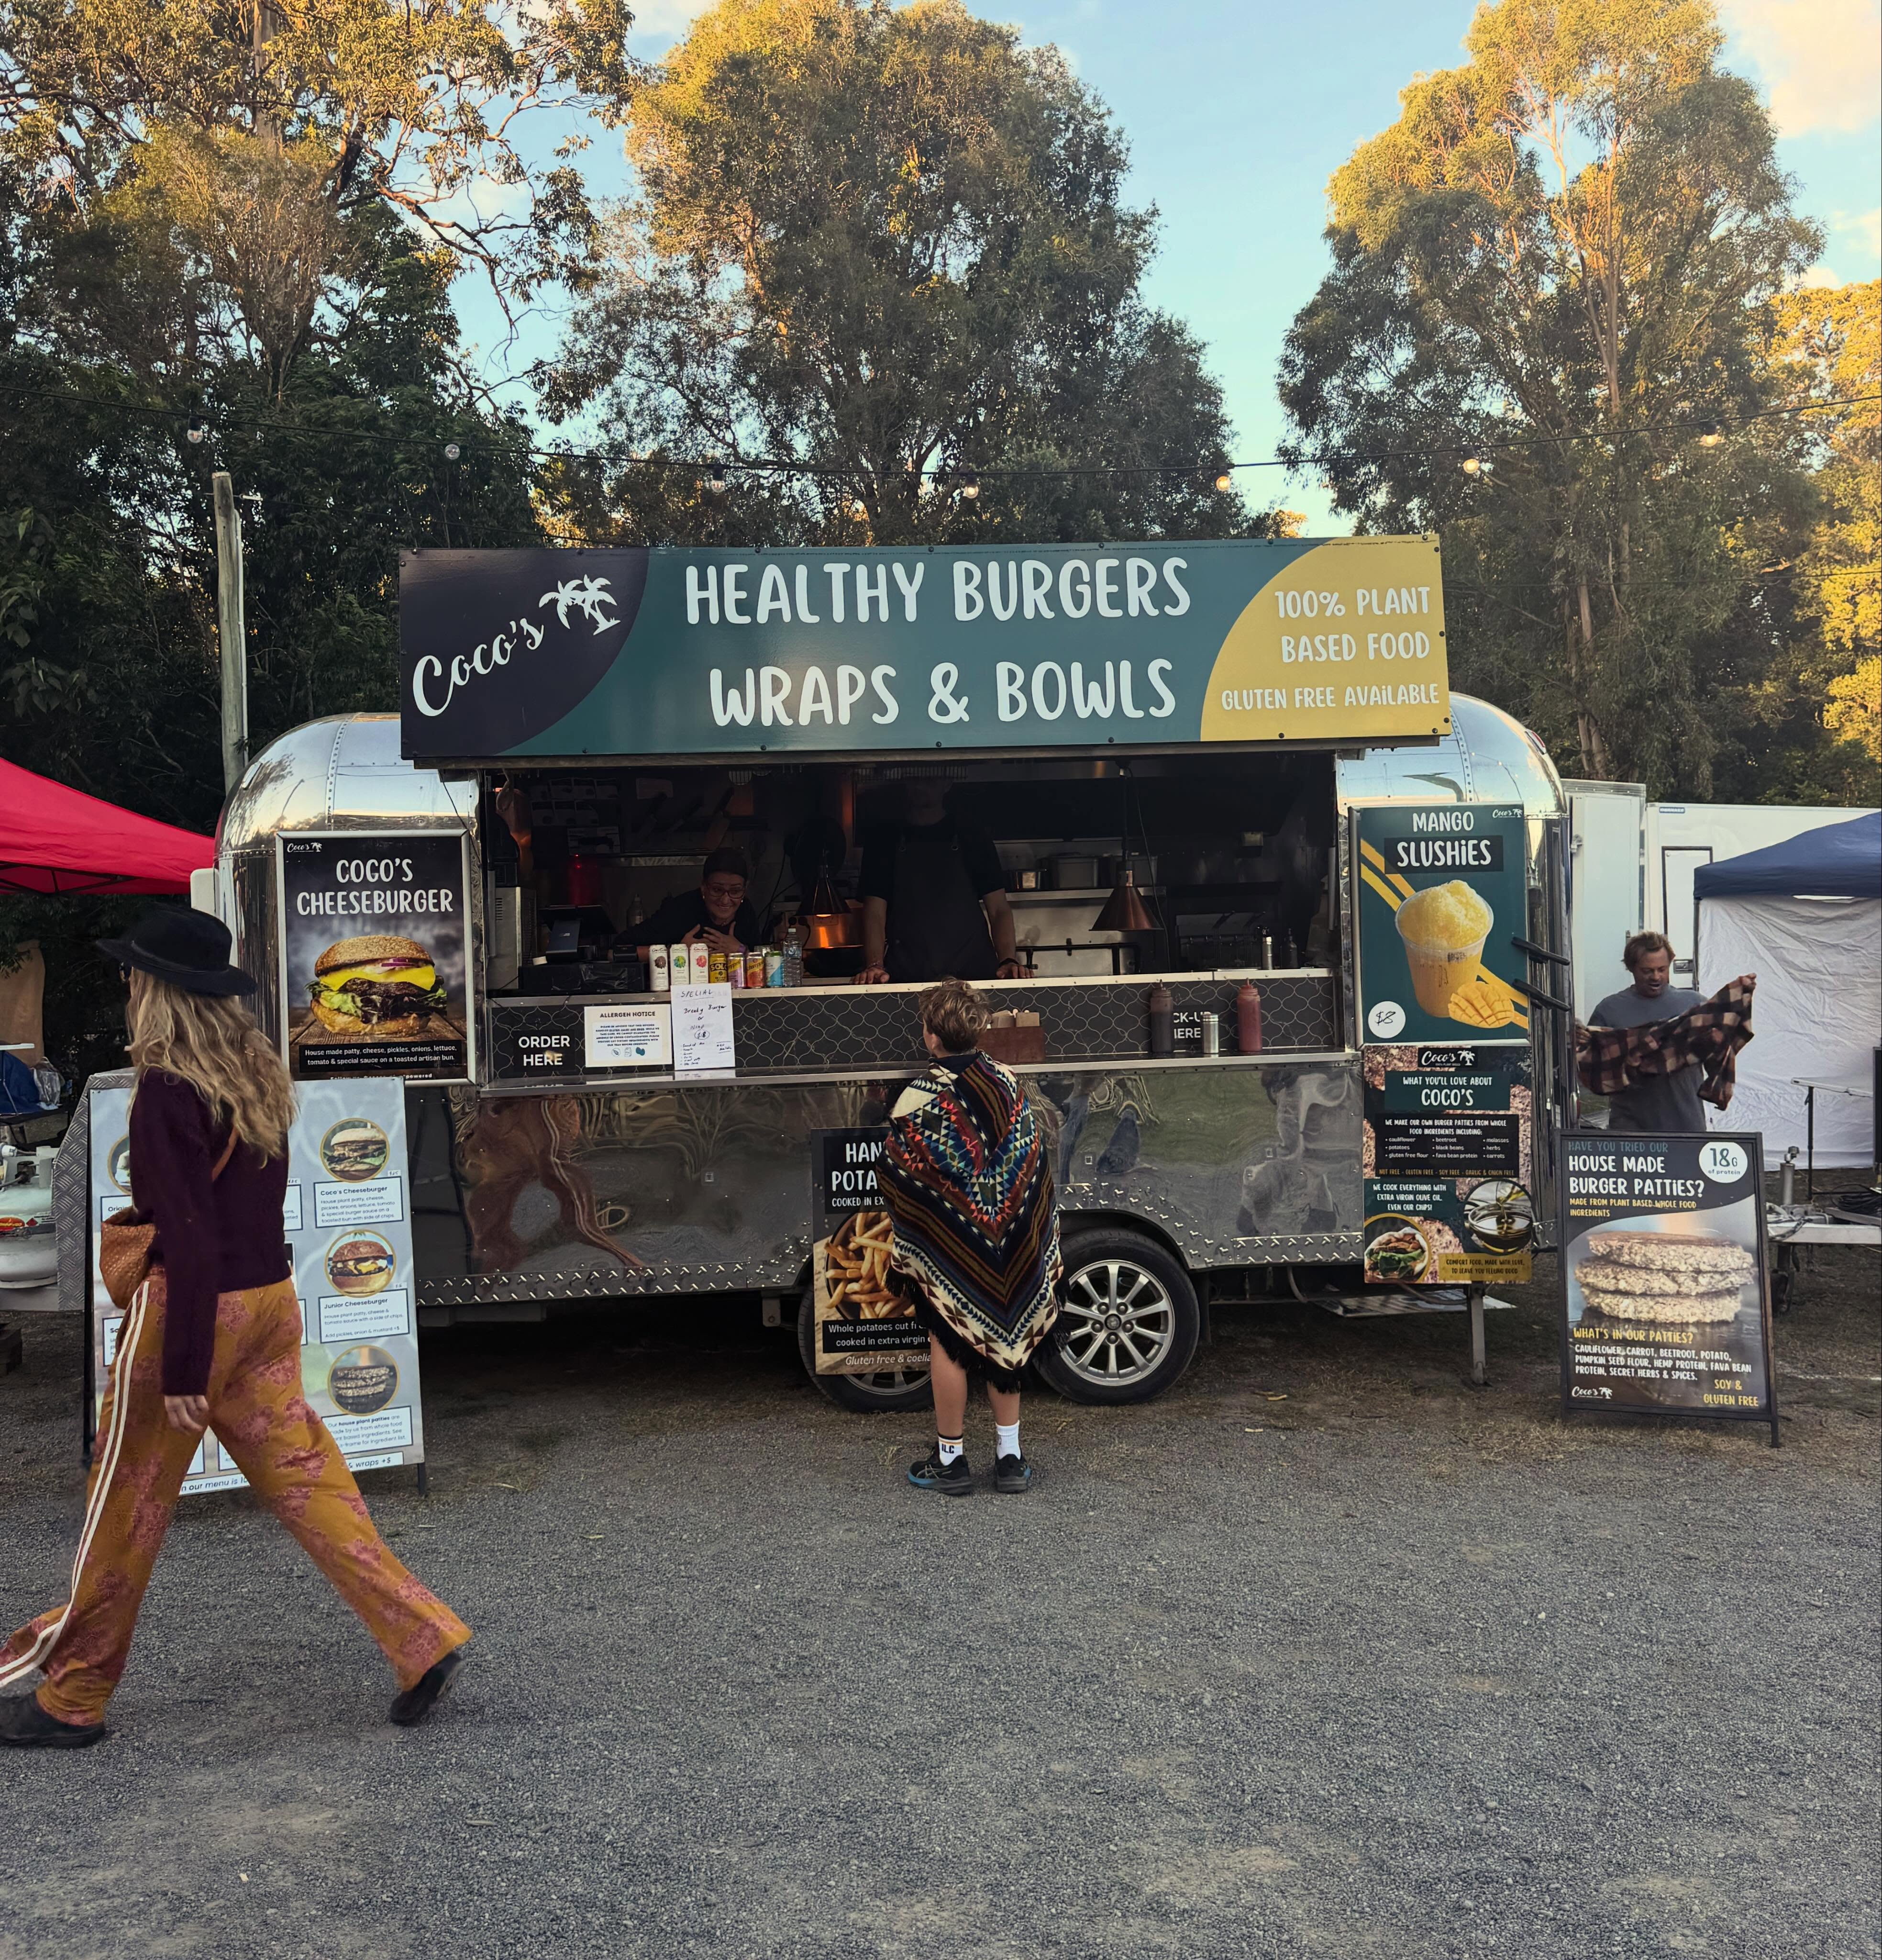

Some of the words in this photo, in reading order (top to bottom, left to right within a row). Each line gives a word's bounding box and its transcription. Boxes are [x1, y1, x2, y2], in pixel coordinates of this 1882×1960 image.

[686, 562, 925, 624] HEALTHY
[954, 557, 1192, 622] BURGERS
[1275, 590, 1346, 619] 100%
[1357, 587, 1429, 616] PLANT
[1282, 634, 1355, 663] BASED
[1368, 632, 1429, 660] FOOD
[413, 614, 544, 717] Coco's
[710, 665, 899, 727] WRAPS
[928, 662, 970, 724] &
[996, 658, 1175, 722] BOWLS
[1221, 689, 1287, 710] GLUTEN
[1295, 687, 1336, 708] FREE
[1413, 811, 1473, 832] MANGO
[336, 858, 413, 883] COCO'S
[297, 889, 453, 915] CHEESEBURGER
[1375, 1011, 1397, 1026] $8
[519, 1036, 570, 1048] ORDER
[523, 1054, 563, 1066] HERE
[1421, 1051, 1457, 1065] Coco's
[1450, 1077, 1467, 1085] LOVE
[1470, 1077, 1493, 1085] ABOUT
[1421, 1089, 1473, 1106] COCO'S
[1568, 1141, 1593, 1152] HAVE
[1597, 1142, 1615, 1152] YOU
[1650, 1142, 1668, 1152] OUR
[1569, 1155, 1616, 1172] HOUSE
[1623, 1156, 1666, 1173] MADE
[343, 1186, 387, 1194] Cheeseburger
[1570, 1177, 1627, 1194] BURGER
[832, 1198, 861, 1207] COOKED
[1610, 1199, 1629, 1207] PLANT
[1632, 1199, 1653, 1207] BASED
[1655, 1200, 1677, 1208] WHOLE
[1570, 1209, 1610, 1217] INGREDIENTS
[345, 1298, 387, 1307] Cheeseburger
[829, 1325, 853, 1333] Whole
[856, 1324, 892, 1333] potatoes
[1573, 1327, 1608, 1339] WHAT'S
[1627, 1330, 1645, 1340] OUR
[836, 1337, 865, 1347] cooked
[868, 1337, 875, 1345] in
[902, 1336, 925, 1345] virgin
[846, 1356, 874, 1365] Gluten
[876, 1355, 895, 1363] free
[898, 1354, 904, 1363] &
[1627, 1347, 1657, 1357] CARROT,
[1660, 1348, 1698, 1359] BEETROOT,
[1700, 1351, 1732, 1361] POTATO,
[1608, 1357, 1625, 1366] SEED
[1627, 1358, 1651, 1368] FLOUR,
[1654, 1359, 1673, 1368] HEMP
[1710, 1363, 1729, 1371] FAVA
[1732, 1364, 1751, 1373] BEAN
[1609, 1367, 1635, 1377] SECRET
[1638, 1370, 1660, 1378] HERBS
[1662, 1370, 1669, 1379] &
[1714, 1379, 1731, 1390] SOY
[1735, 1380, 1742, 1390] &
[1703, 1394, 1735, 1405] GLUTEN
[1738, 1395, 1759, 1406] FREE
[356, 1459, 379, 1468] wraps
